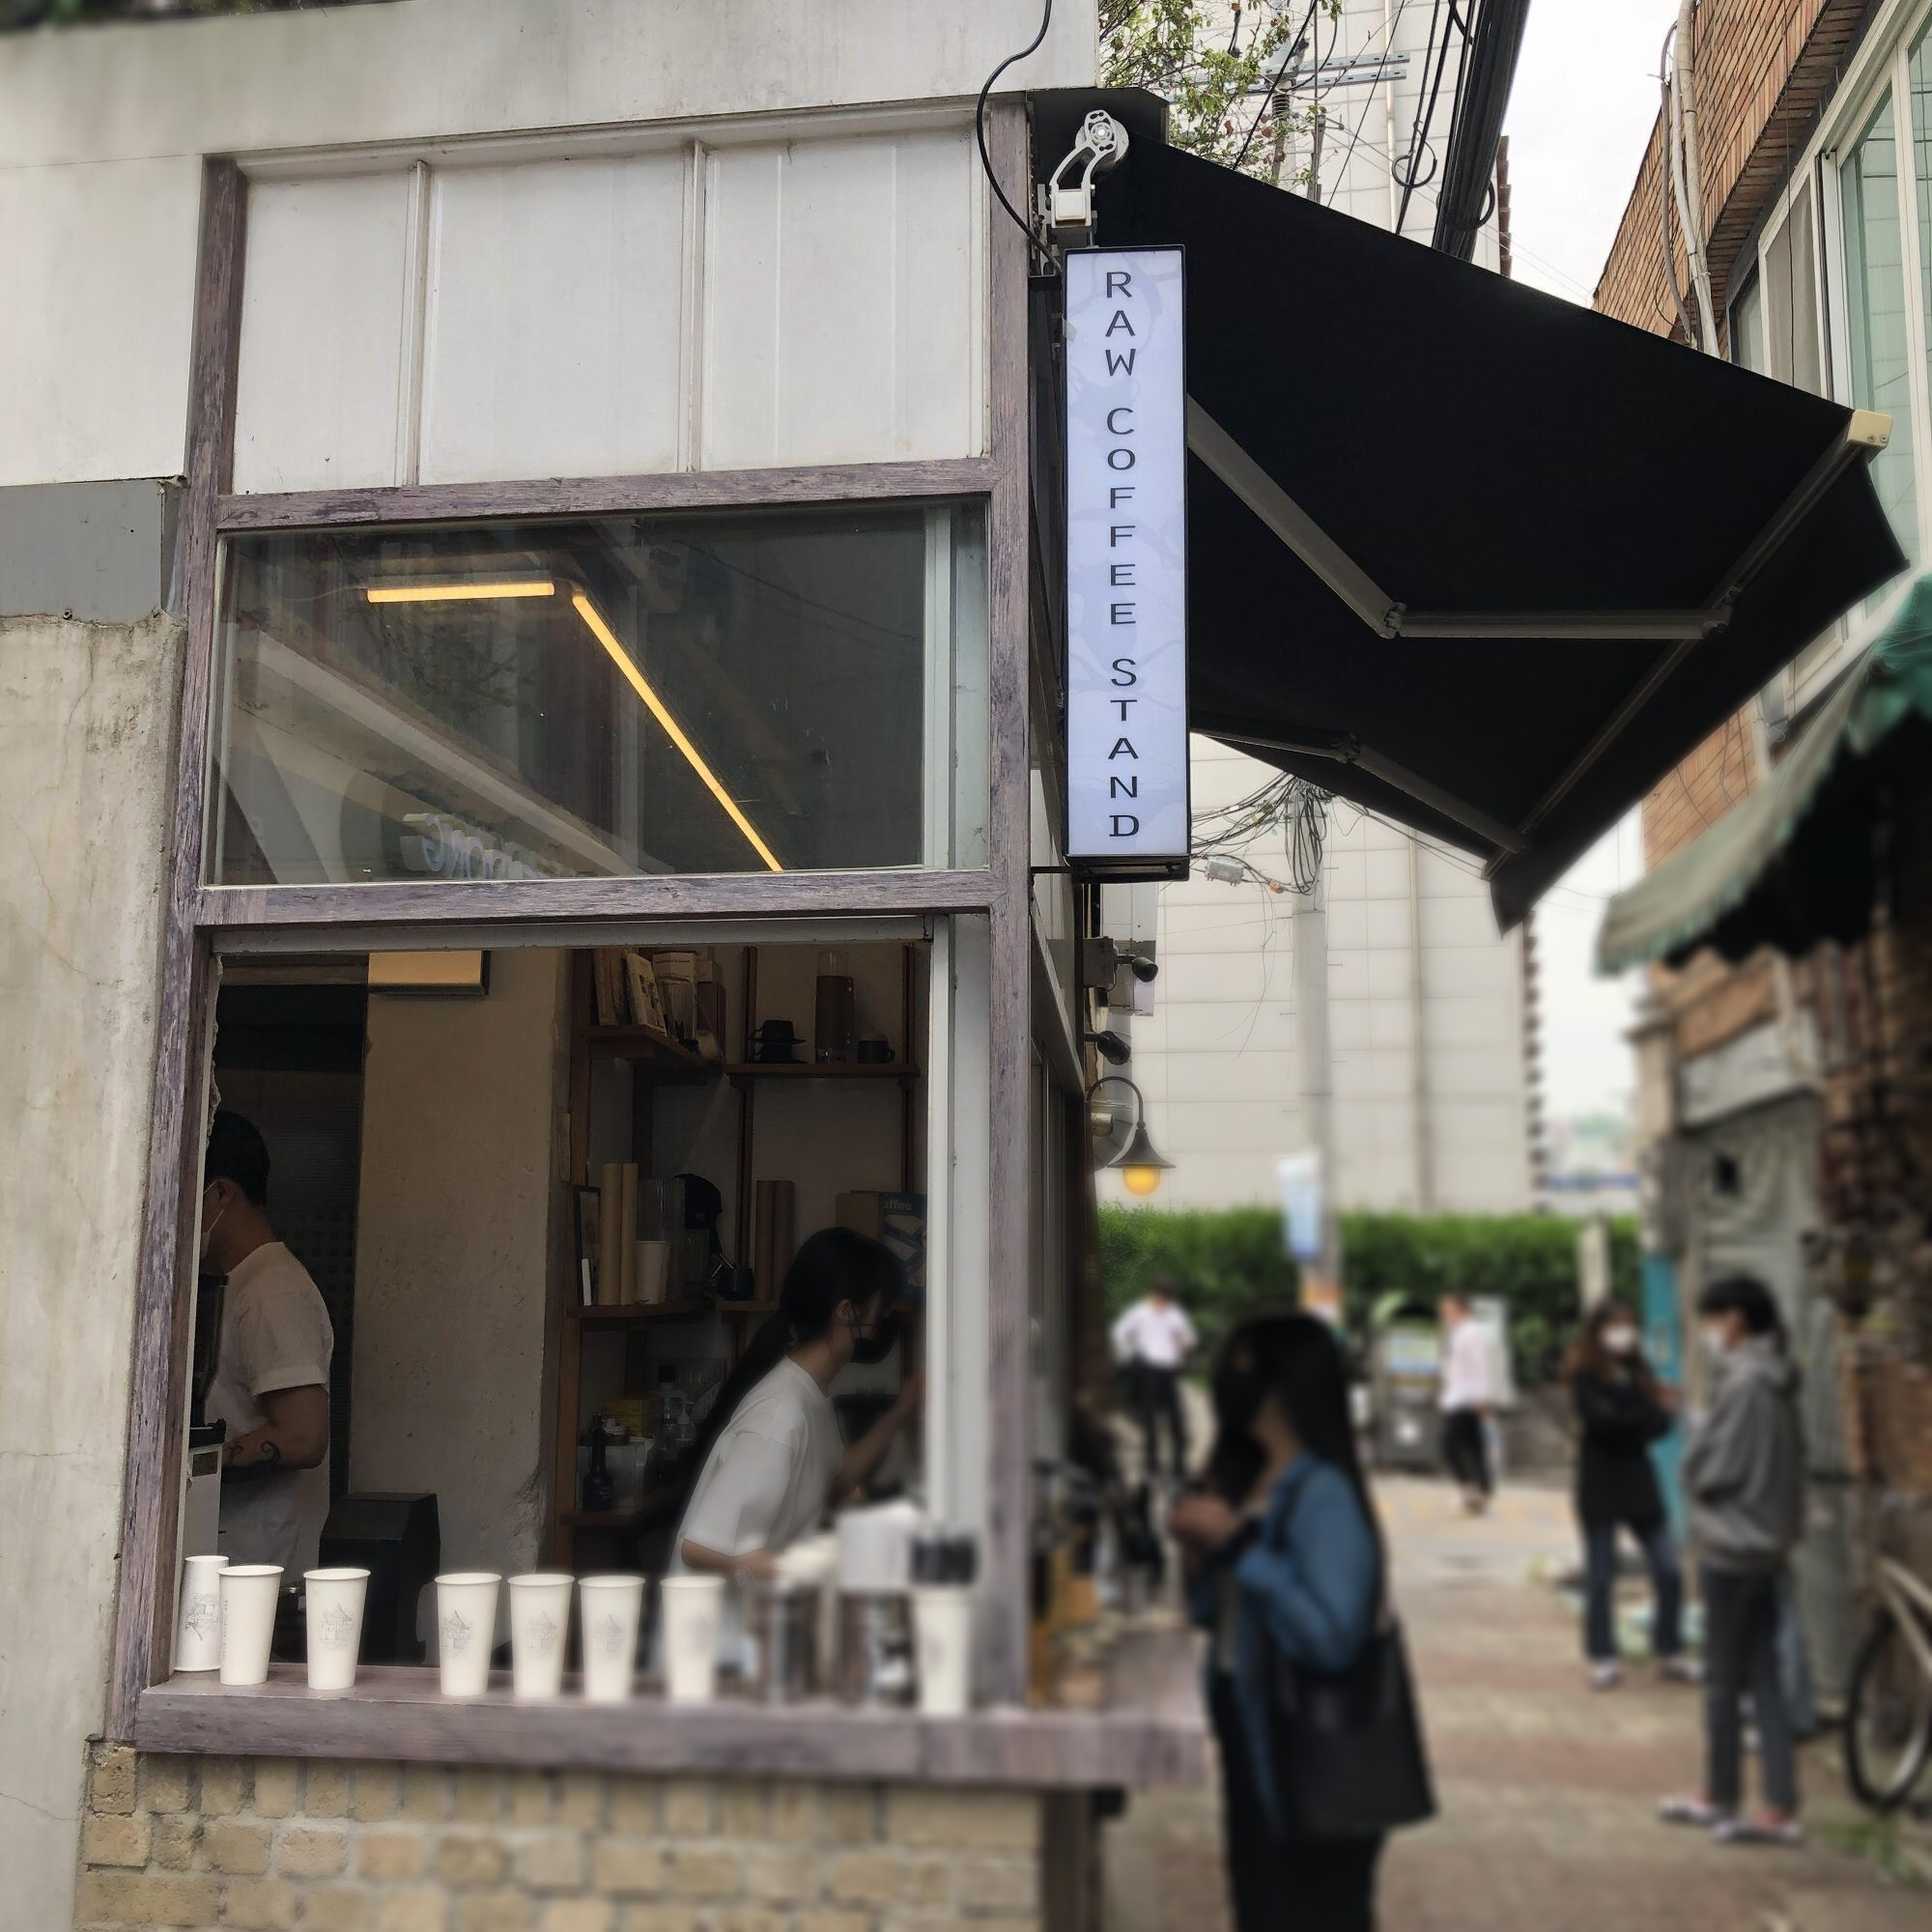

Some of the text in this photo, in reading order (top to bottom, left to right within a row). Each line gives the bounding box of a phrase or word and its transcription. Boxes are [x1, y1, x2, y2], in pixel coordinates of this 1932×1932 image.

[1105, 271, 1140, 838] RAW COFFEE STAND
